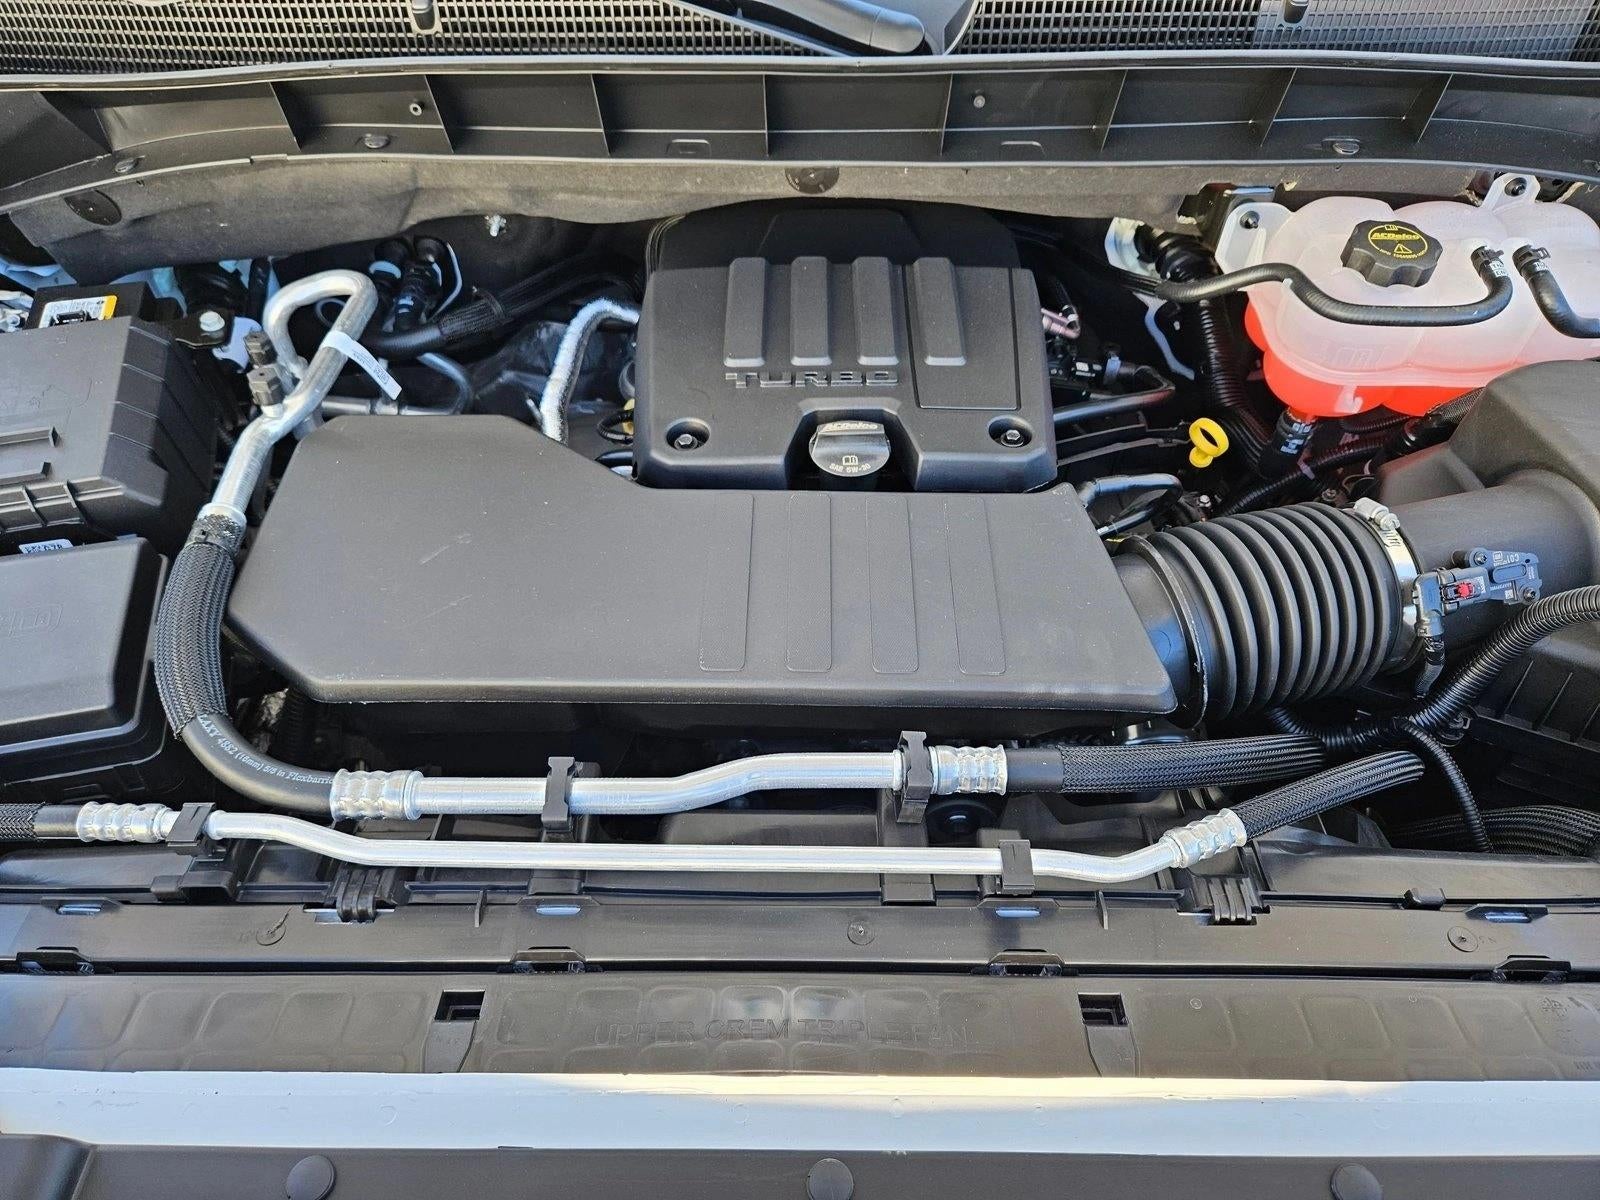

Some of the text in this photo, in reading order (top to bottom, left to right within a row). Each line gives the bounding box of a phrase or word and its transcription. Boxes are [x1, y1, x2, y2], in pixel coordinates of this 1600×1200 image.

[725, 370, 899, 389] TURBO
[217, 738, 239, 755] 4882
[593, 1020, 697, 1047] UPPER
[797, 1018, 902, 1044] TRIPLE
